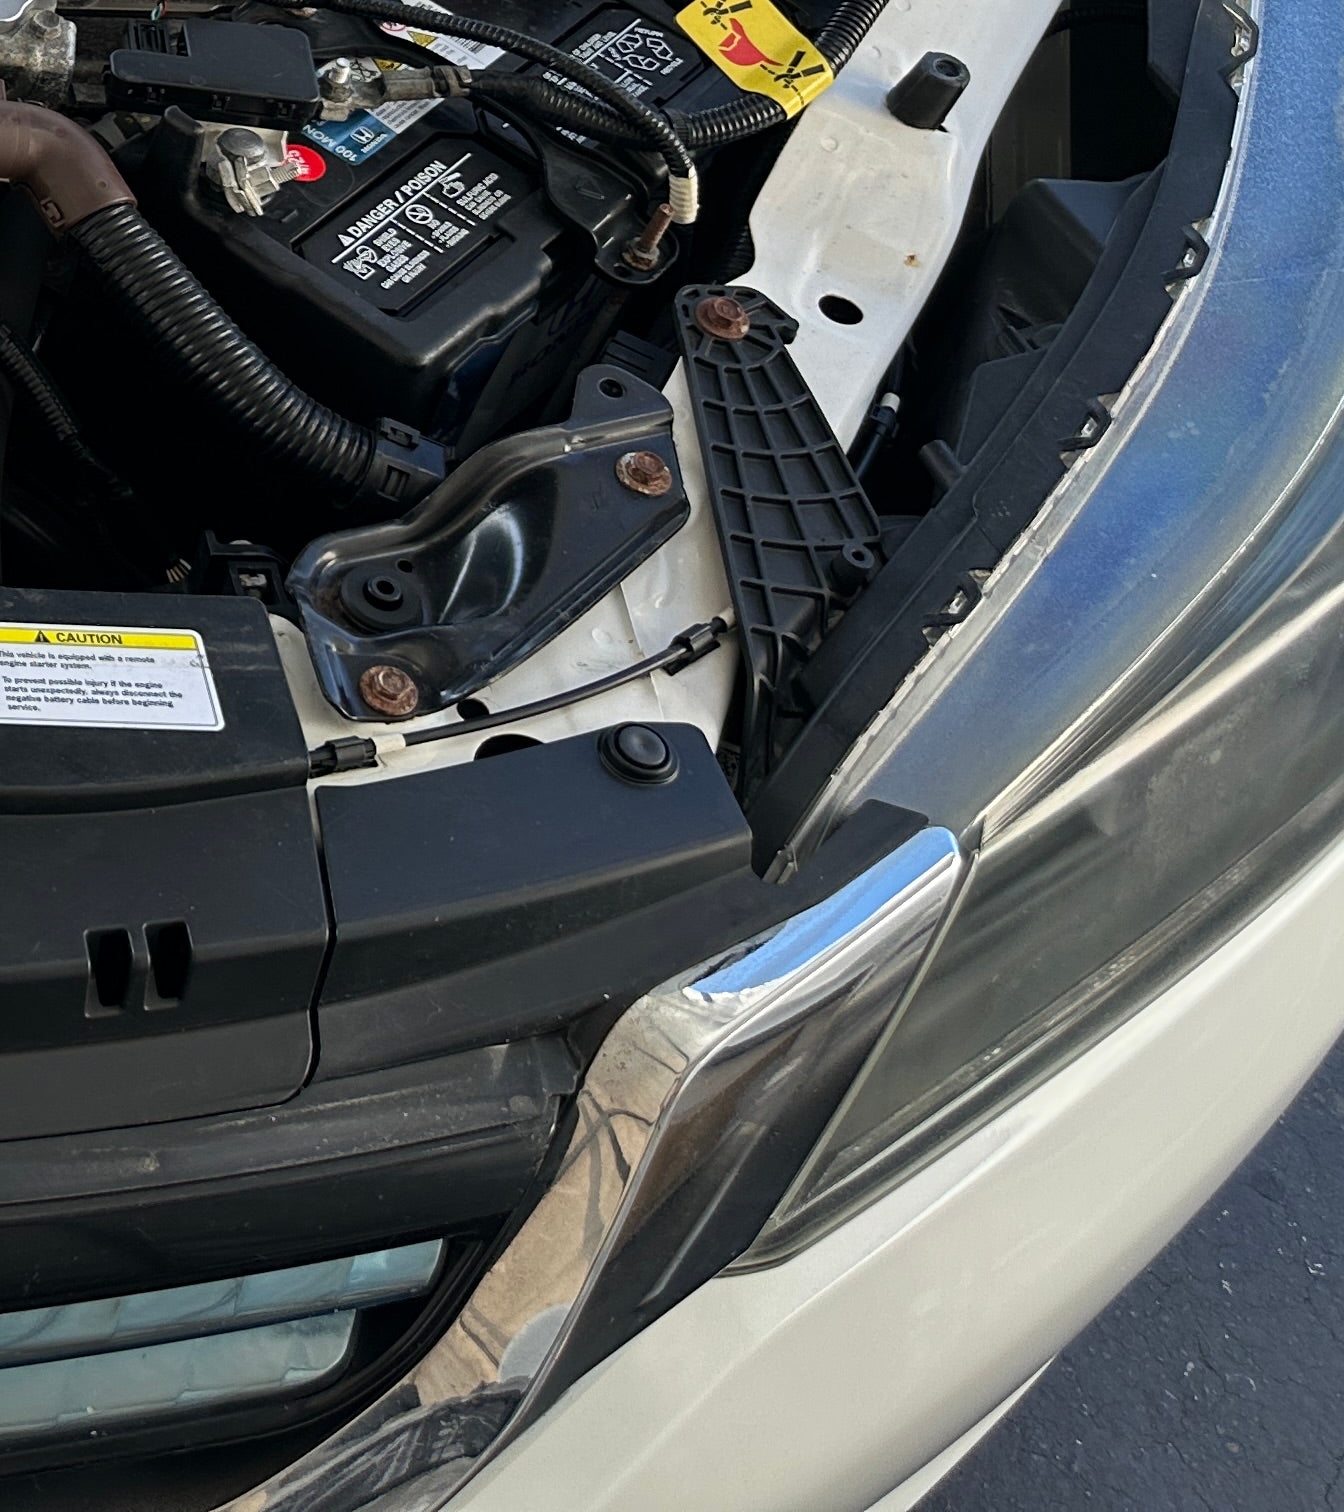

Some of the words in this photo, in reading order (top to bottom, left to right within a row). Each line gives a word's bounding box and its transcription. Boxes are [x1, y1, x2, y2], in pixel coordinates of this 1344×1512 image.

[335, 145, 360, 162] 100
[346, 197, 400, 239] DANGER
[400, 160, 448, 197] POISON
[56, 632, 123, 645] CAUTION
[58, 653, 96, 661] equipped
[2, 675, 12, 683] To
[134, 681, 163, 689] engine
[44, 696, 74, 704] battery
[169, 690, 183, 698] the
